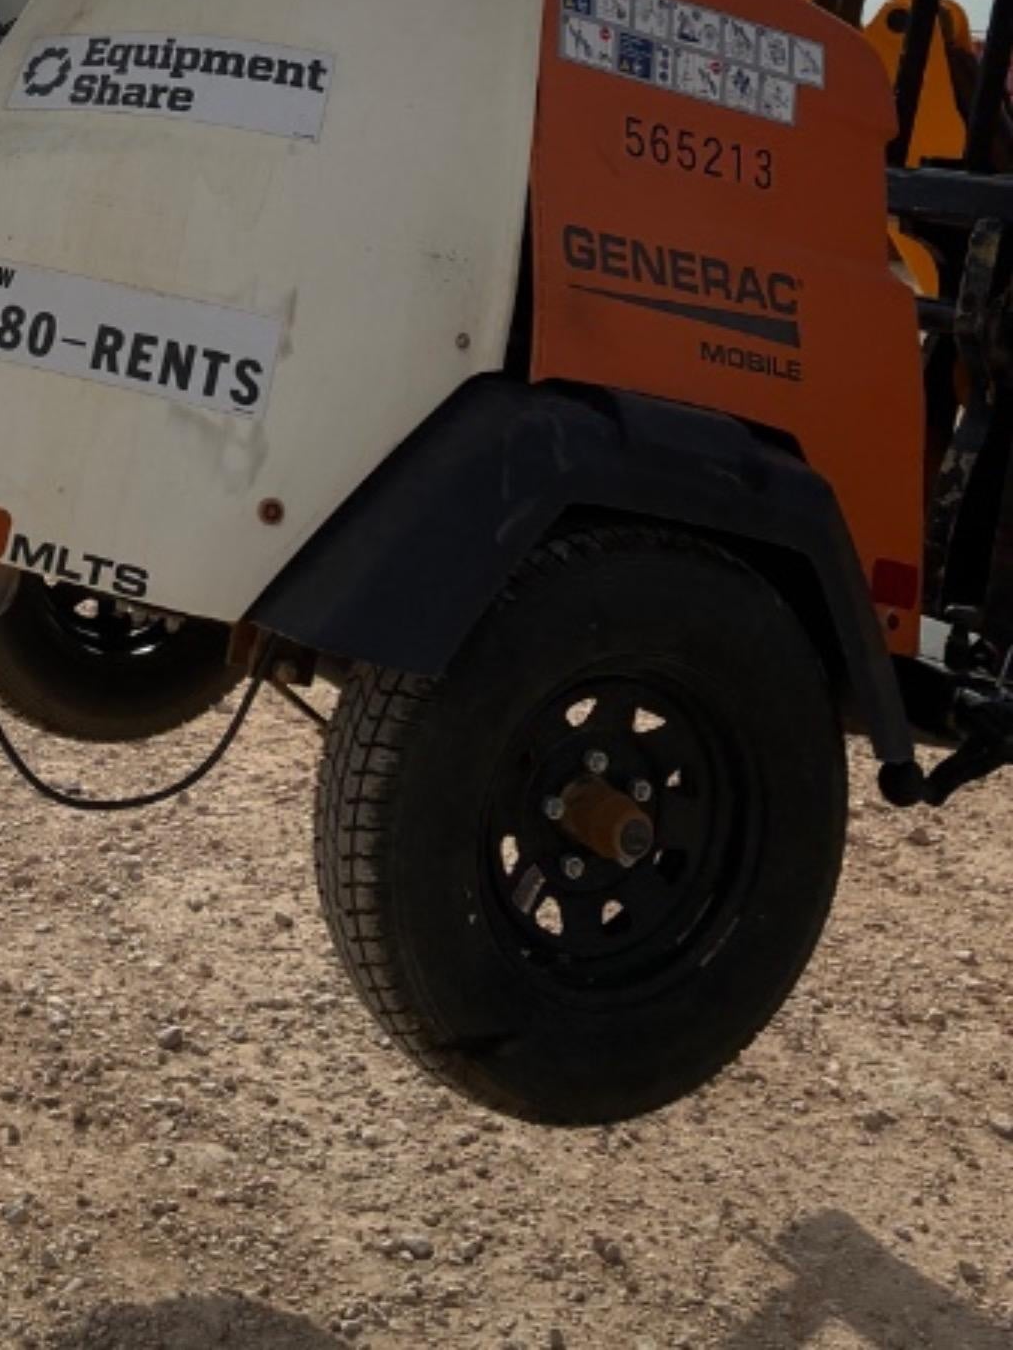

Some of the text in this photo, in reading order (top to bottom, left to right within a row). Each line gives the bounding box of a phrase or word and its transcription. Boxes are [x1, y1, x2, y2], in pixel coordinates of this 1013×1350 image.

[69, 73, 195, 112] Share
[80, 37, 328, 92] Equipment
[624, 116, 773, 190] 565213
[562, 224, 798, 315] GENERAC
[699, 341, 803, 382] MOBILE
[9, 533, 149, 598] MLTS
